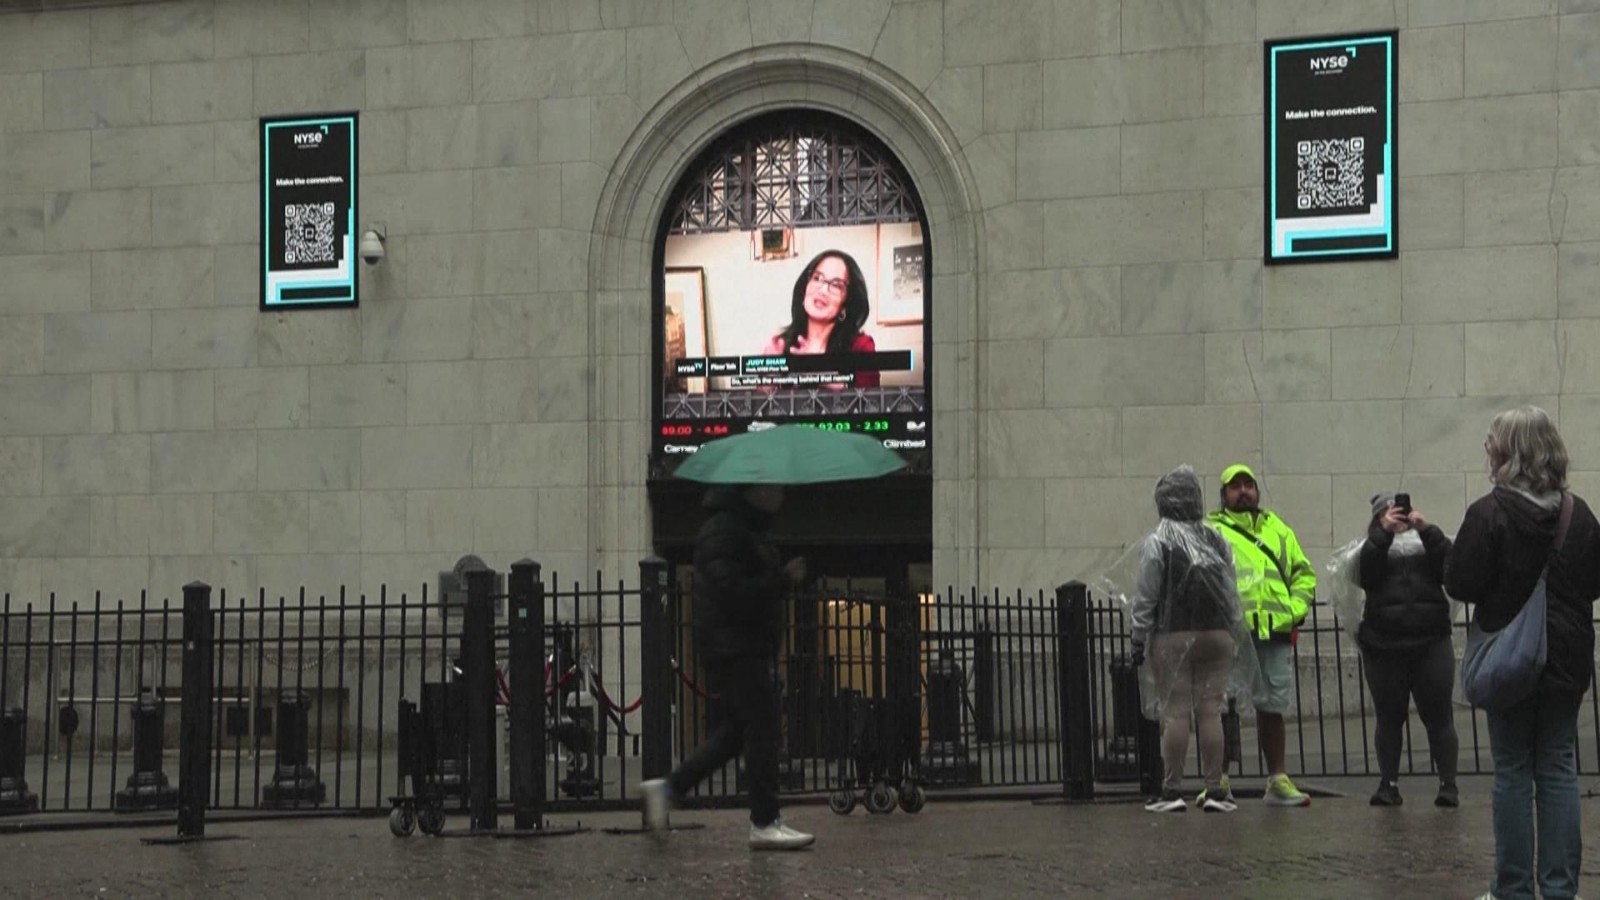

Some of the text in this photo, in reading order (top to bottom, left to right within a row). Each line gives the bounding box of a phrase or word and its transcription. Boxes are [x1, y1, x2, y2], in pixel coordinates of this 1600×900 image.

[1285, 105, 1377, 120] Make the connection.
[275, 175, 344, 187] Make the connection.
[710, 362, 737, 371] Floor Talk
[745, 358, 787, 367] JUDY SHAW
[762, 376, 772, 385] the
[772, 376, 798, 386] meaning
[798, 374, 820, 383] behind
[820, 373, 832, 383] that
[832, 372, 854, 382] name?
[882, 439, 926, 449] Climbed
